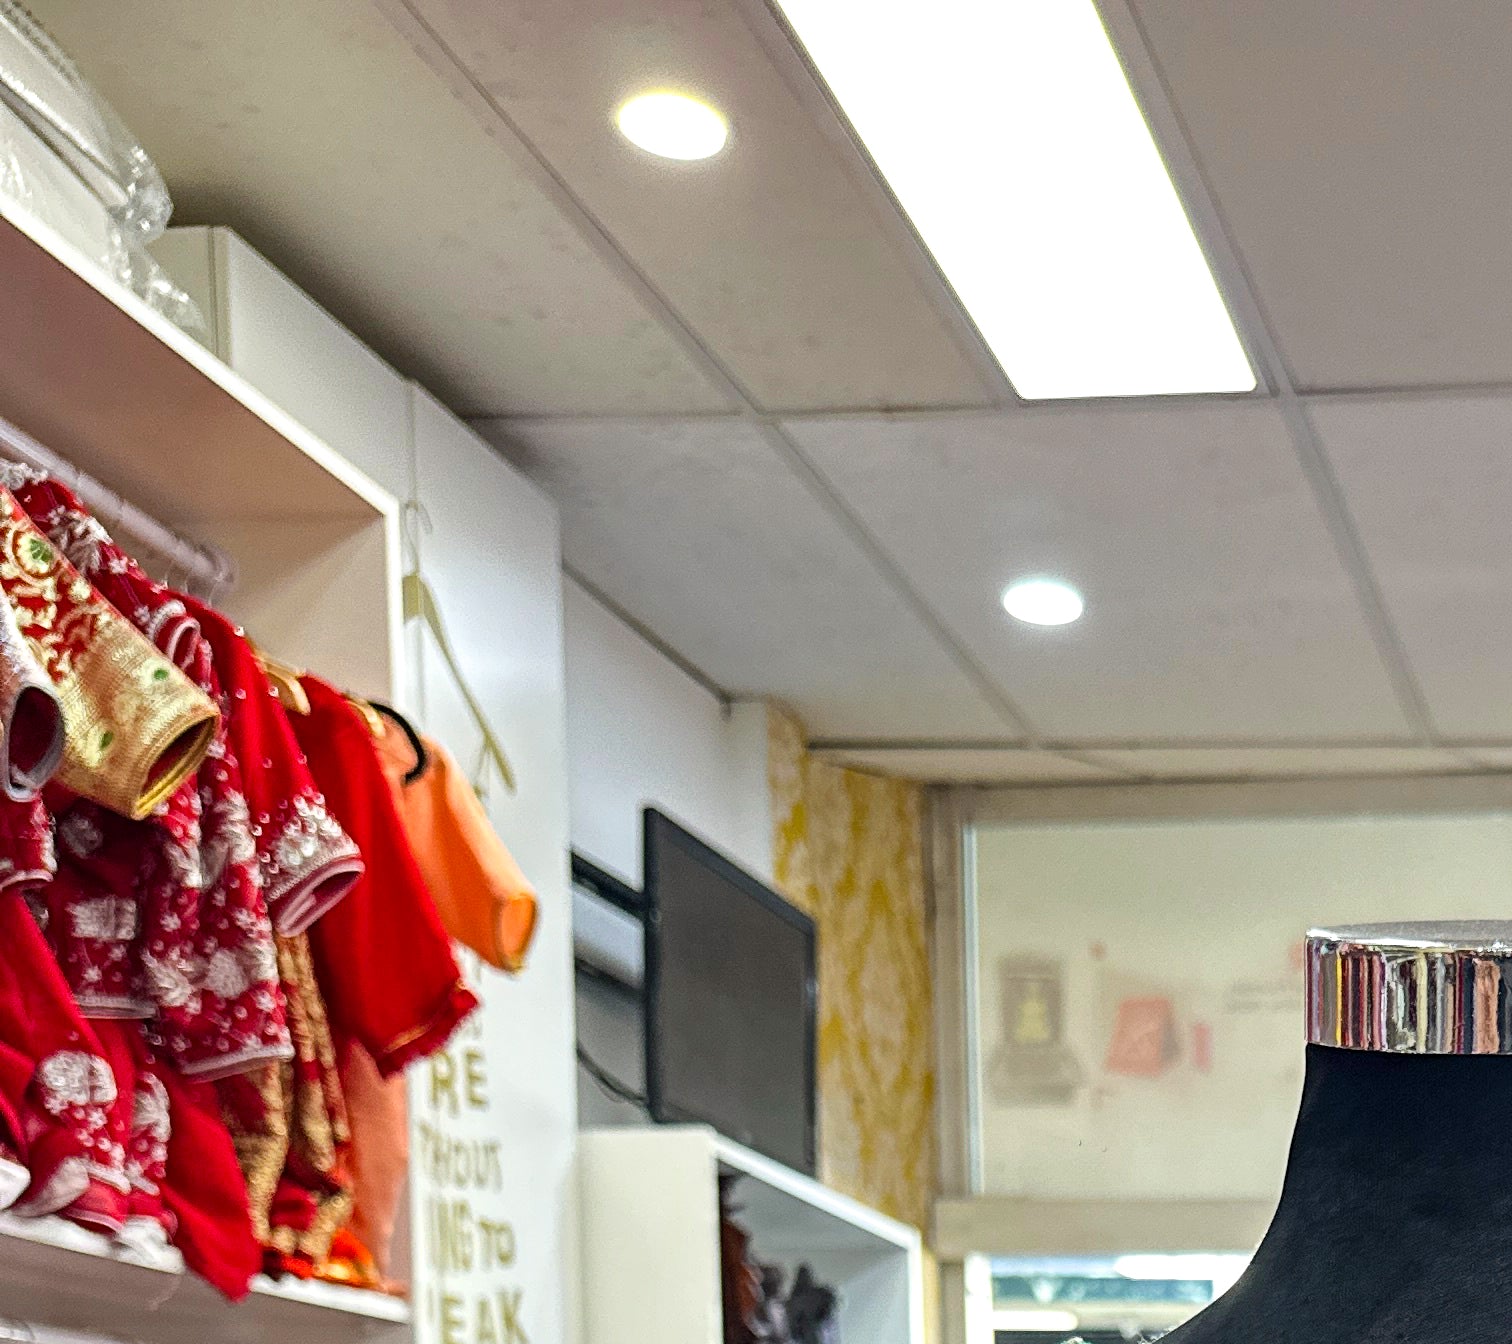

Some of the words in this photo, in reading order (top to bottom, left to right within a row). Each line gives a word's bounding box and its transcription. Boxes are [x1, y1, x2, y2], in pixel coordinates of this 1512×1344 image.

[429, 1047, 490, 1113] RE
[418, 1121, 504, 1192] THOUT
[479, 1217, 518, 1271] TO
